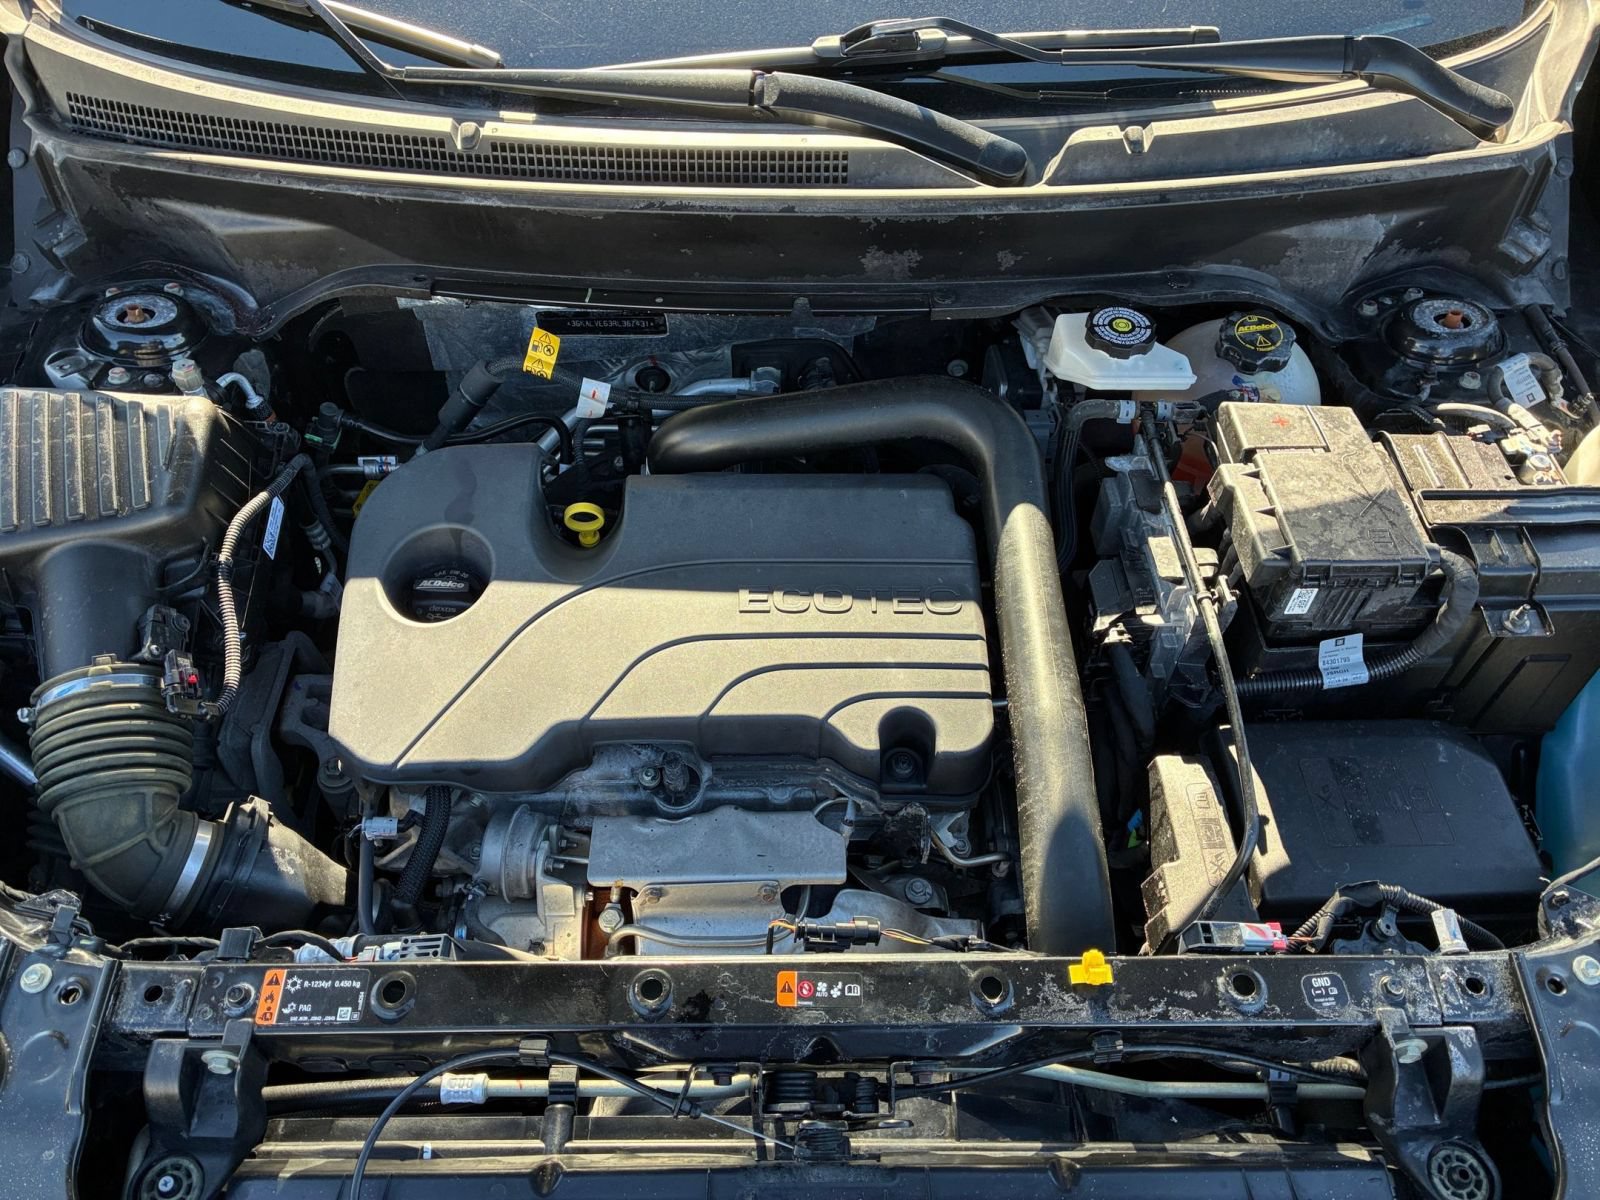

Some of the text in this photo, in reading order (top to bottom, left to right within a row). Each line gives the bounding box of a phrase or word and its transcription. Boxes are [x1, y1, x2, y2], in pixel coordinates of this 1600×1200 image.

[1238, 324, 1276, 332] ACDelco
[418, 580, 465, 588] ACDelco
[739, 584, 963, 615] ECOTEC
[303, 980, 361, 989] R-1234yf 0.450 kg
[1311, 976, 1331, 987] GND
[298, 1004, 312, 1012] PAG
